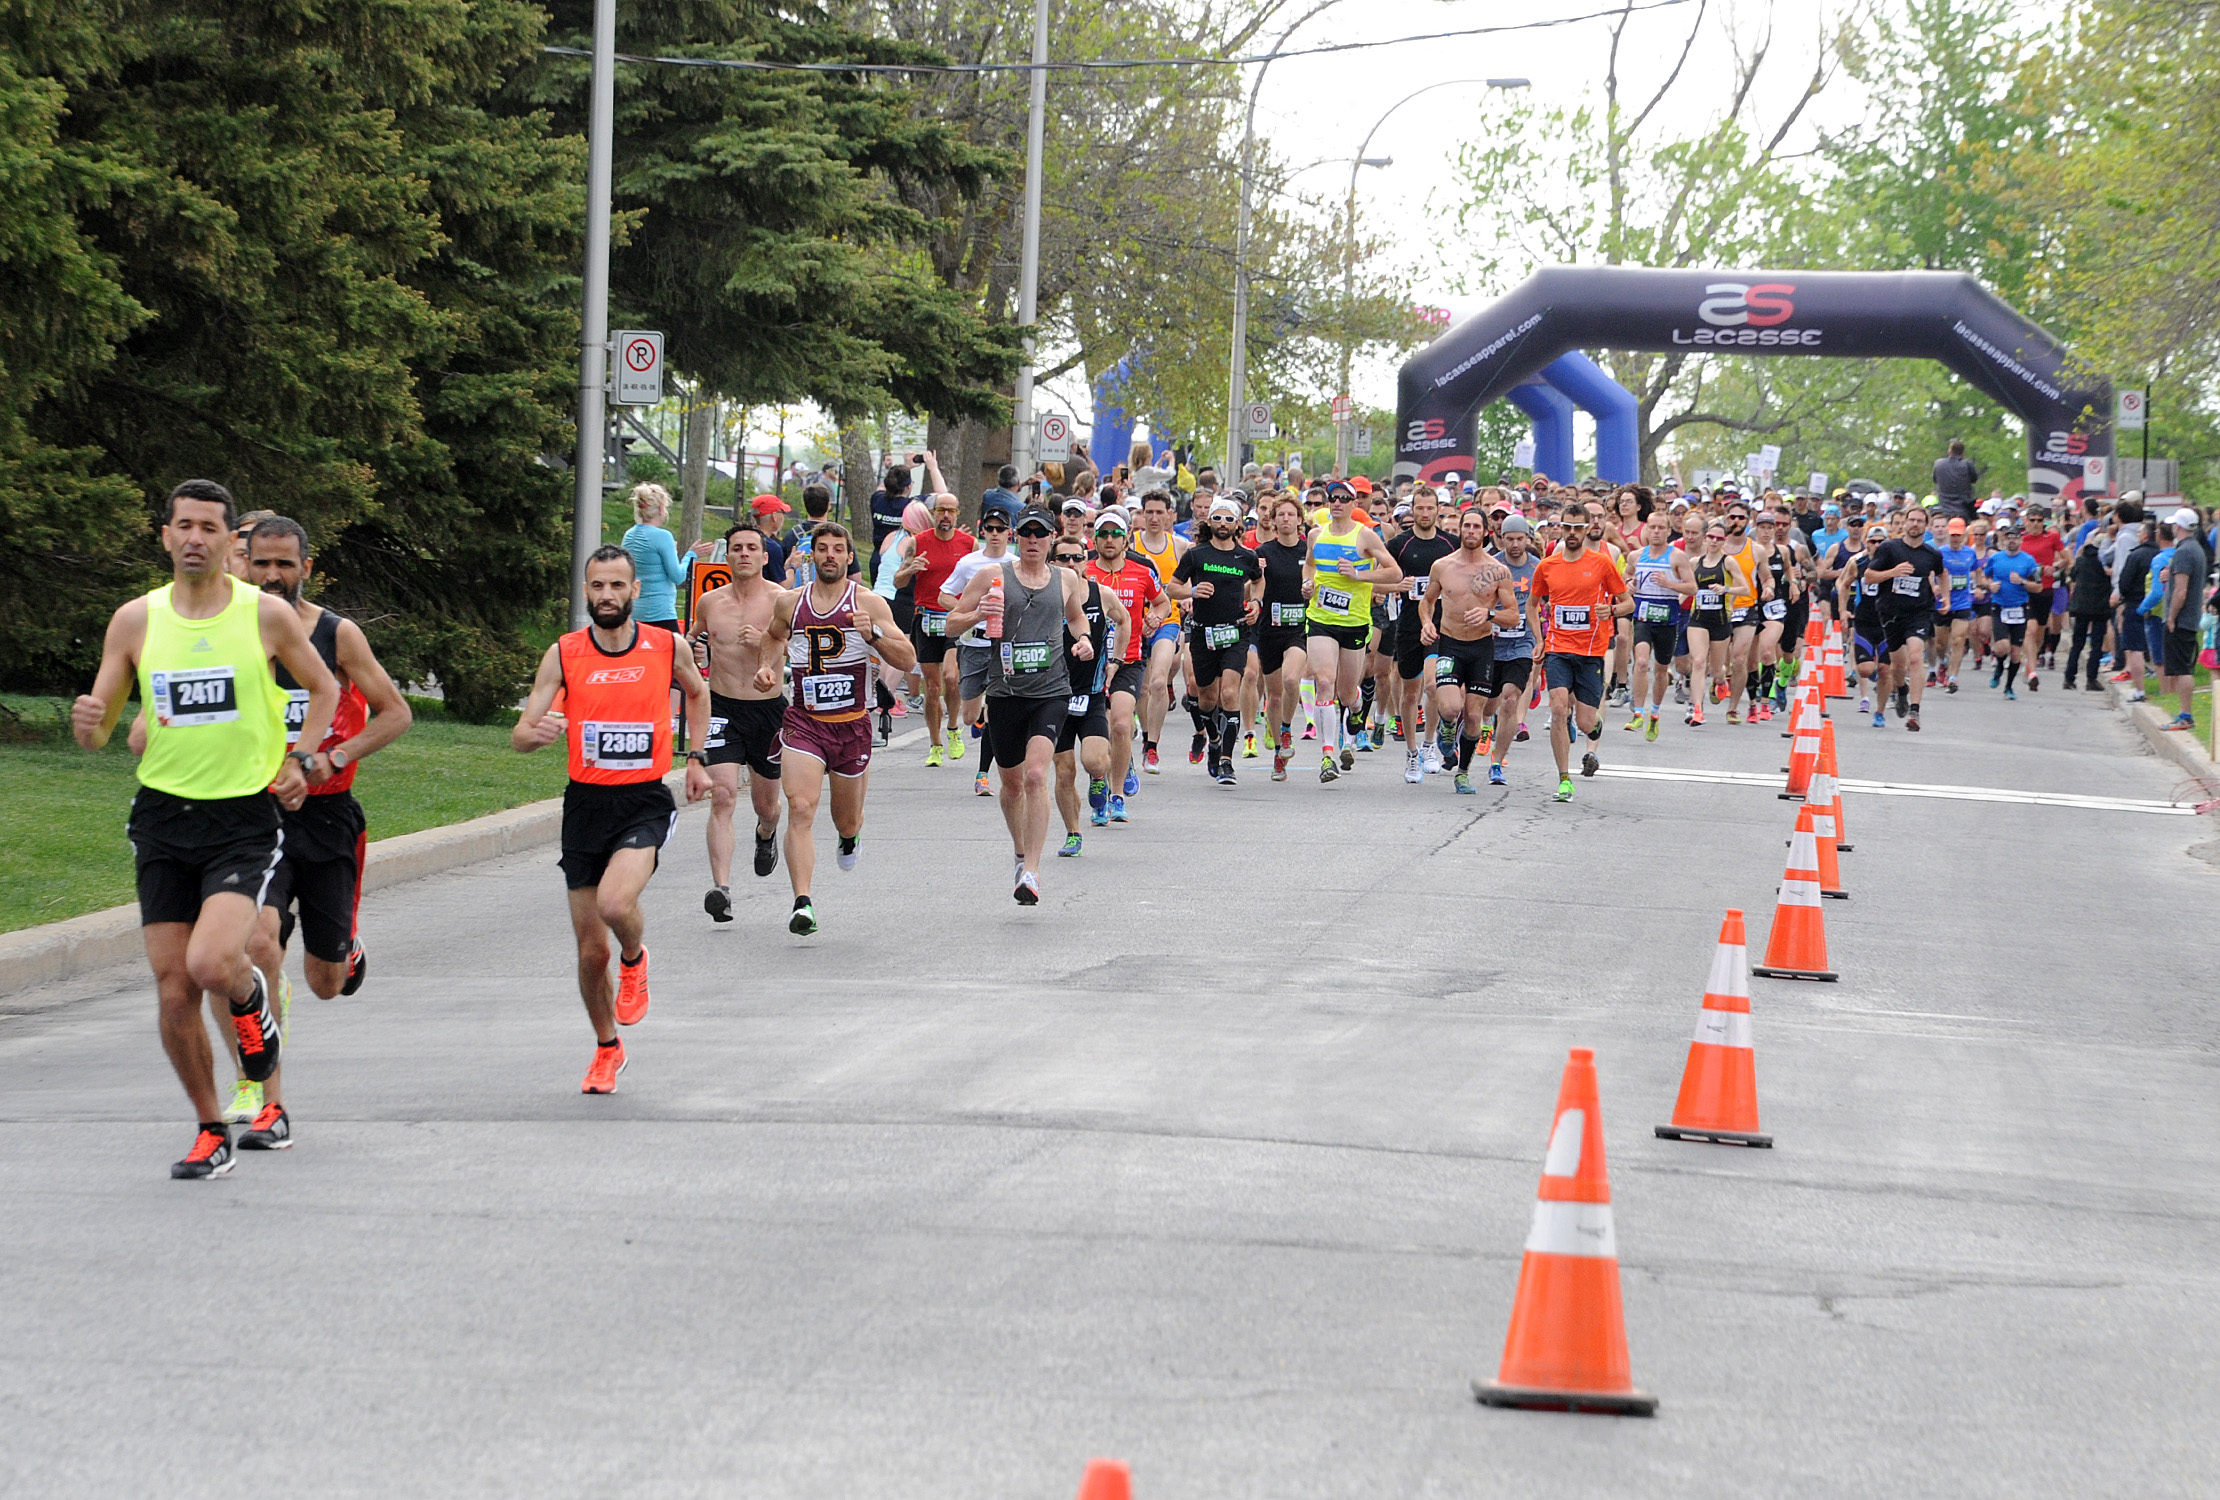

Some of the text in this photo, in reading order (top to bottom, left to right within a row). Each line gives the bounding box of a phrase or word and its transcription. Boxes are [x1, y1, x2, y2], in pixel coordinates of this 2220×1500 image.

[1434, 313, 1542, 388] lacasseapparel.com
[1326, 594, 1349, 607] 2443
[1282, 609, 1303, 618] 2753
[1565, 612, 1586, 621] 1670
[1213, 631, 1236, 642] 2644
[805, 625, 845, 677] P
[1014, 649, 1046, 662] 2502
[177, 680, 226, 706] 2417
[819, 682, 852, 697] 2232
[1069, 695, 1085, 706] 47
[602, 733, 649, 753] 2386
